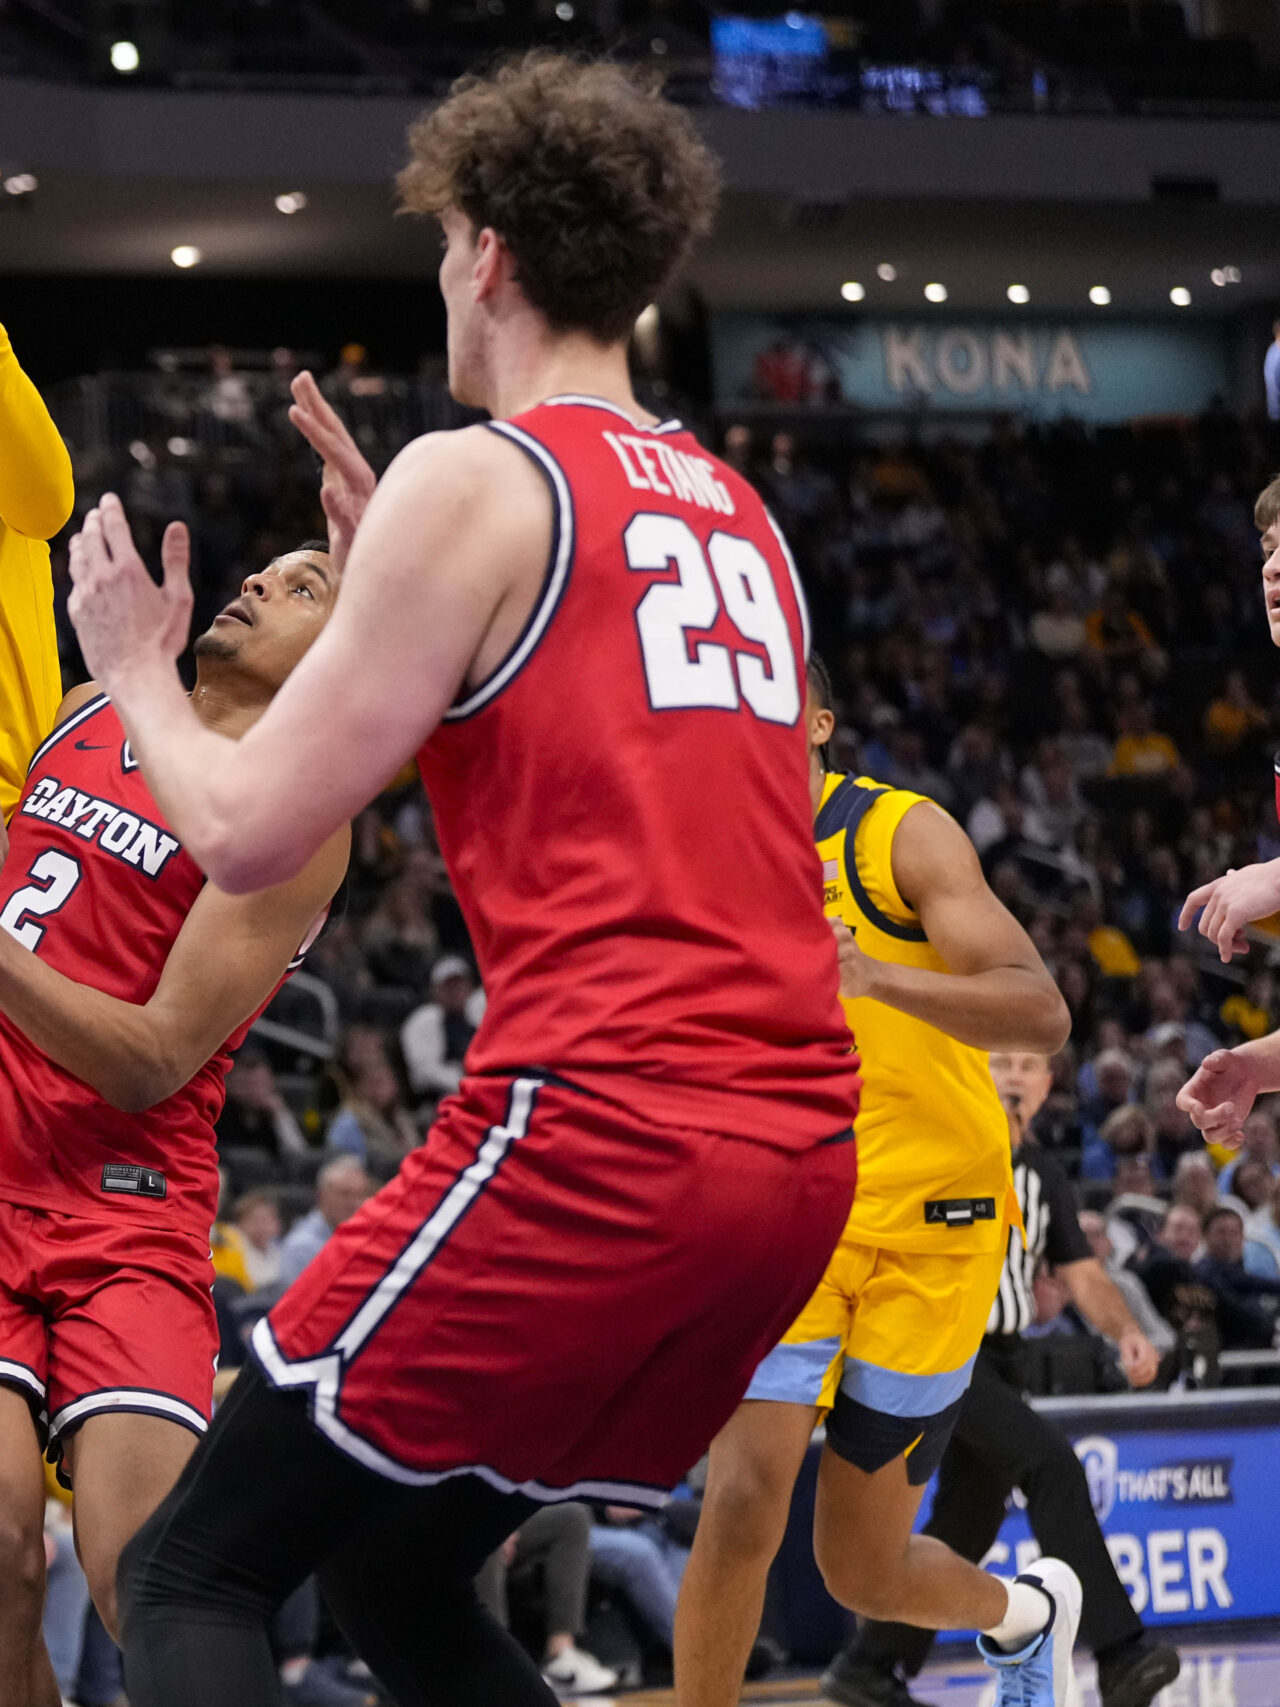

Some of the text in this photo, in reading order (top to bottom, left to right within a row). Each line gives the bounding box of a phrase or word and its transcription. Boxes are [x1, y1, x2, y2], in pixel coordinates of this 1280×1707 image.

[883, 322, 1092, 394] KONA
[623, 511, 801, 728] 29
[21, 775, 183, 882] DAYTON
[148, 1176, 156, 1187] L
[1117, 1464, 1229, 1502] THAT'S ALL
